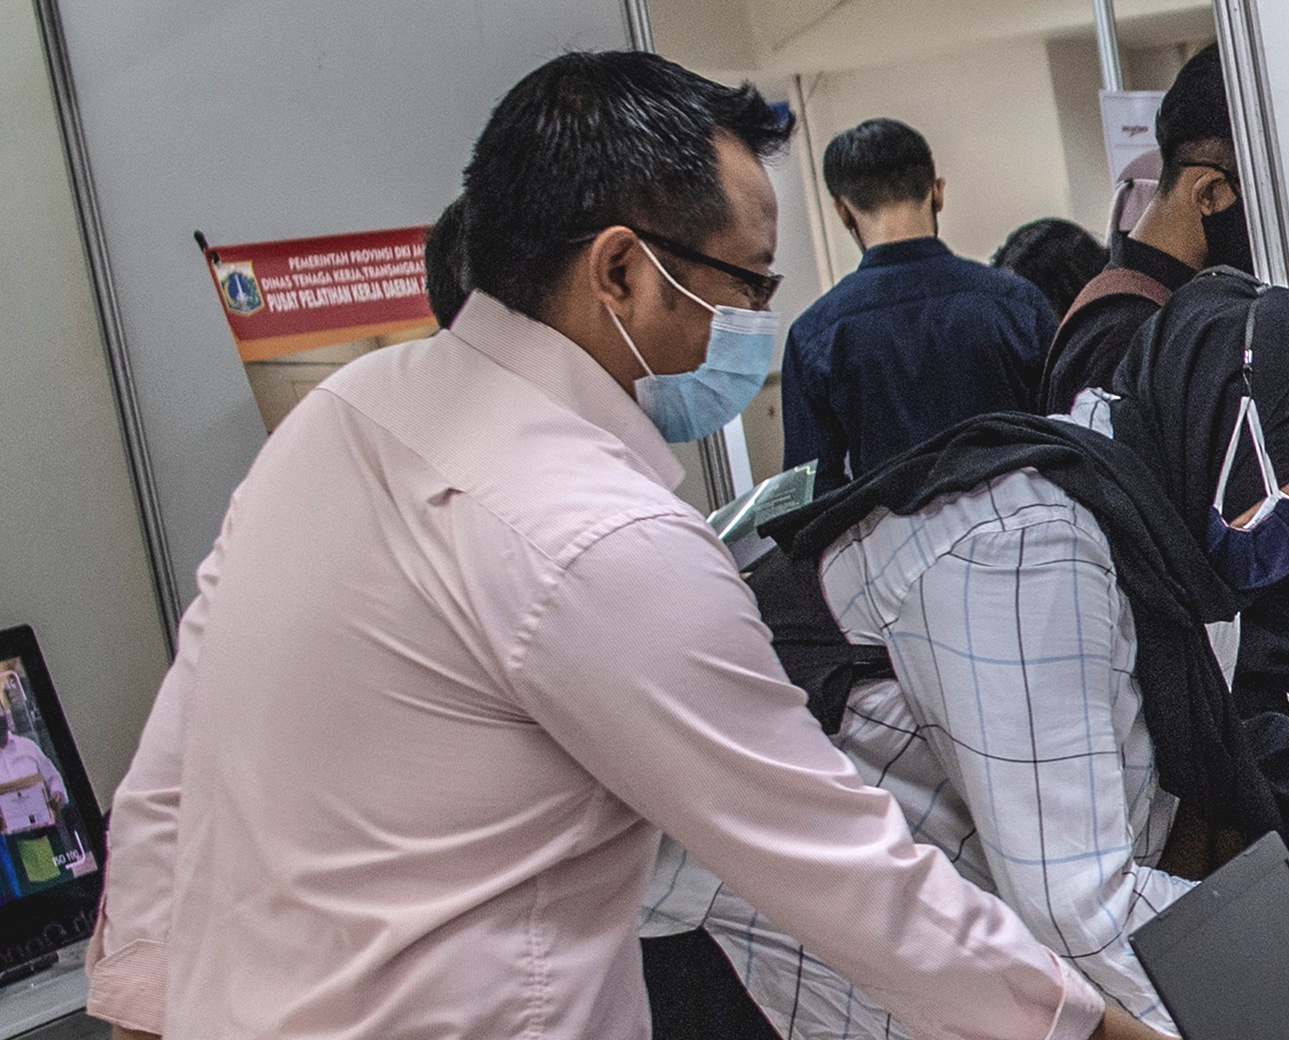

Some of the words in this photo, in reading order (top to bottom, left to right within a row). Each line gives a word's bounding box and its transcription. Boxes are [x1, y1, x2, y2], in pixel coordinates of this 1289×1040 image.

[288, 252, 349, 270] PEMERINTAH
[350, 246, 393, 263] PROVINSI
[394, 245, 412, 259] DKI
[261, 275, 293, 292] DINAS
[293, 271, 333, 287] TENAGA
[266, 291, 300, 312] PUSAT
[300, 284, 353, 309] PELATIHAN
[350, 280, 384, 302] KERJA
[382, 277, 424, 299] DAERAH
